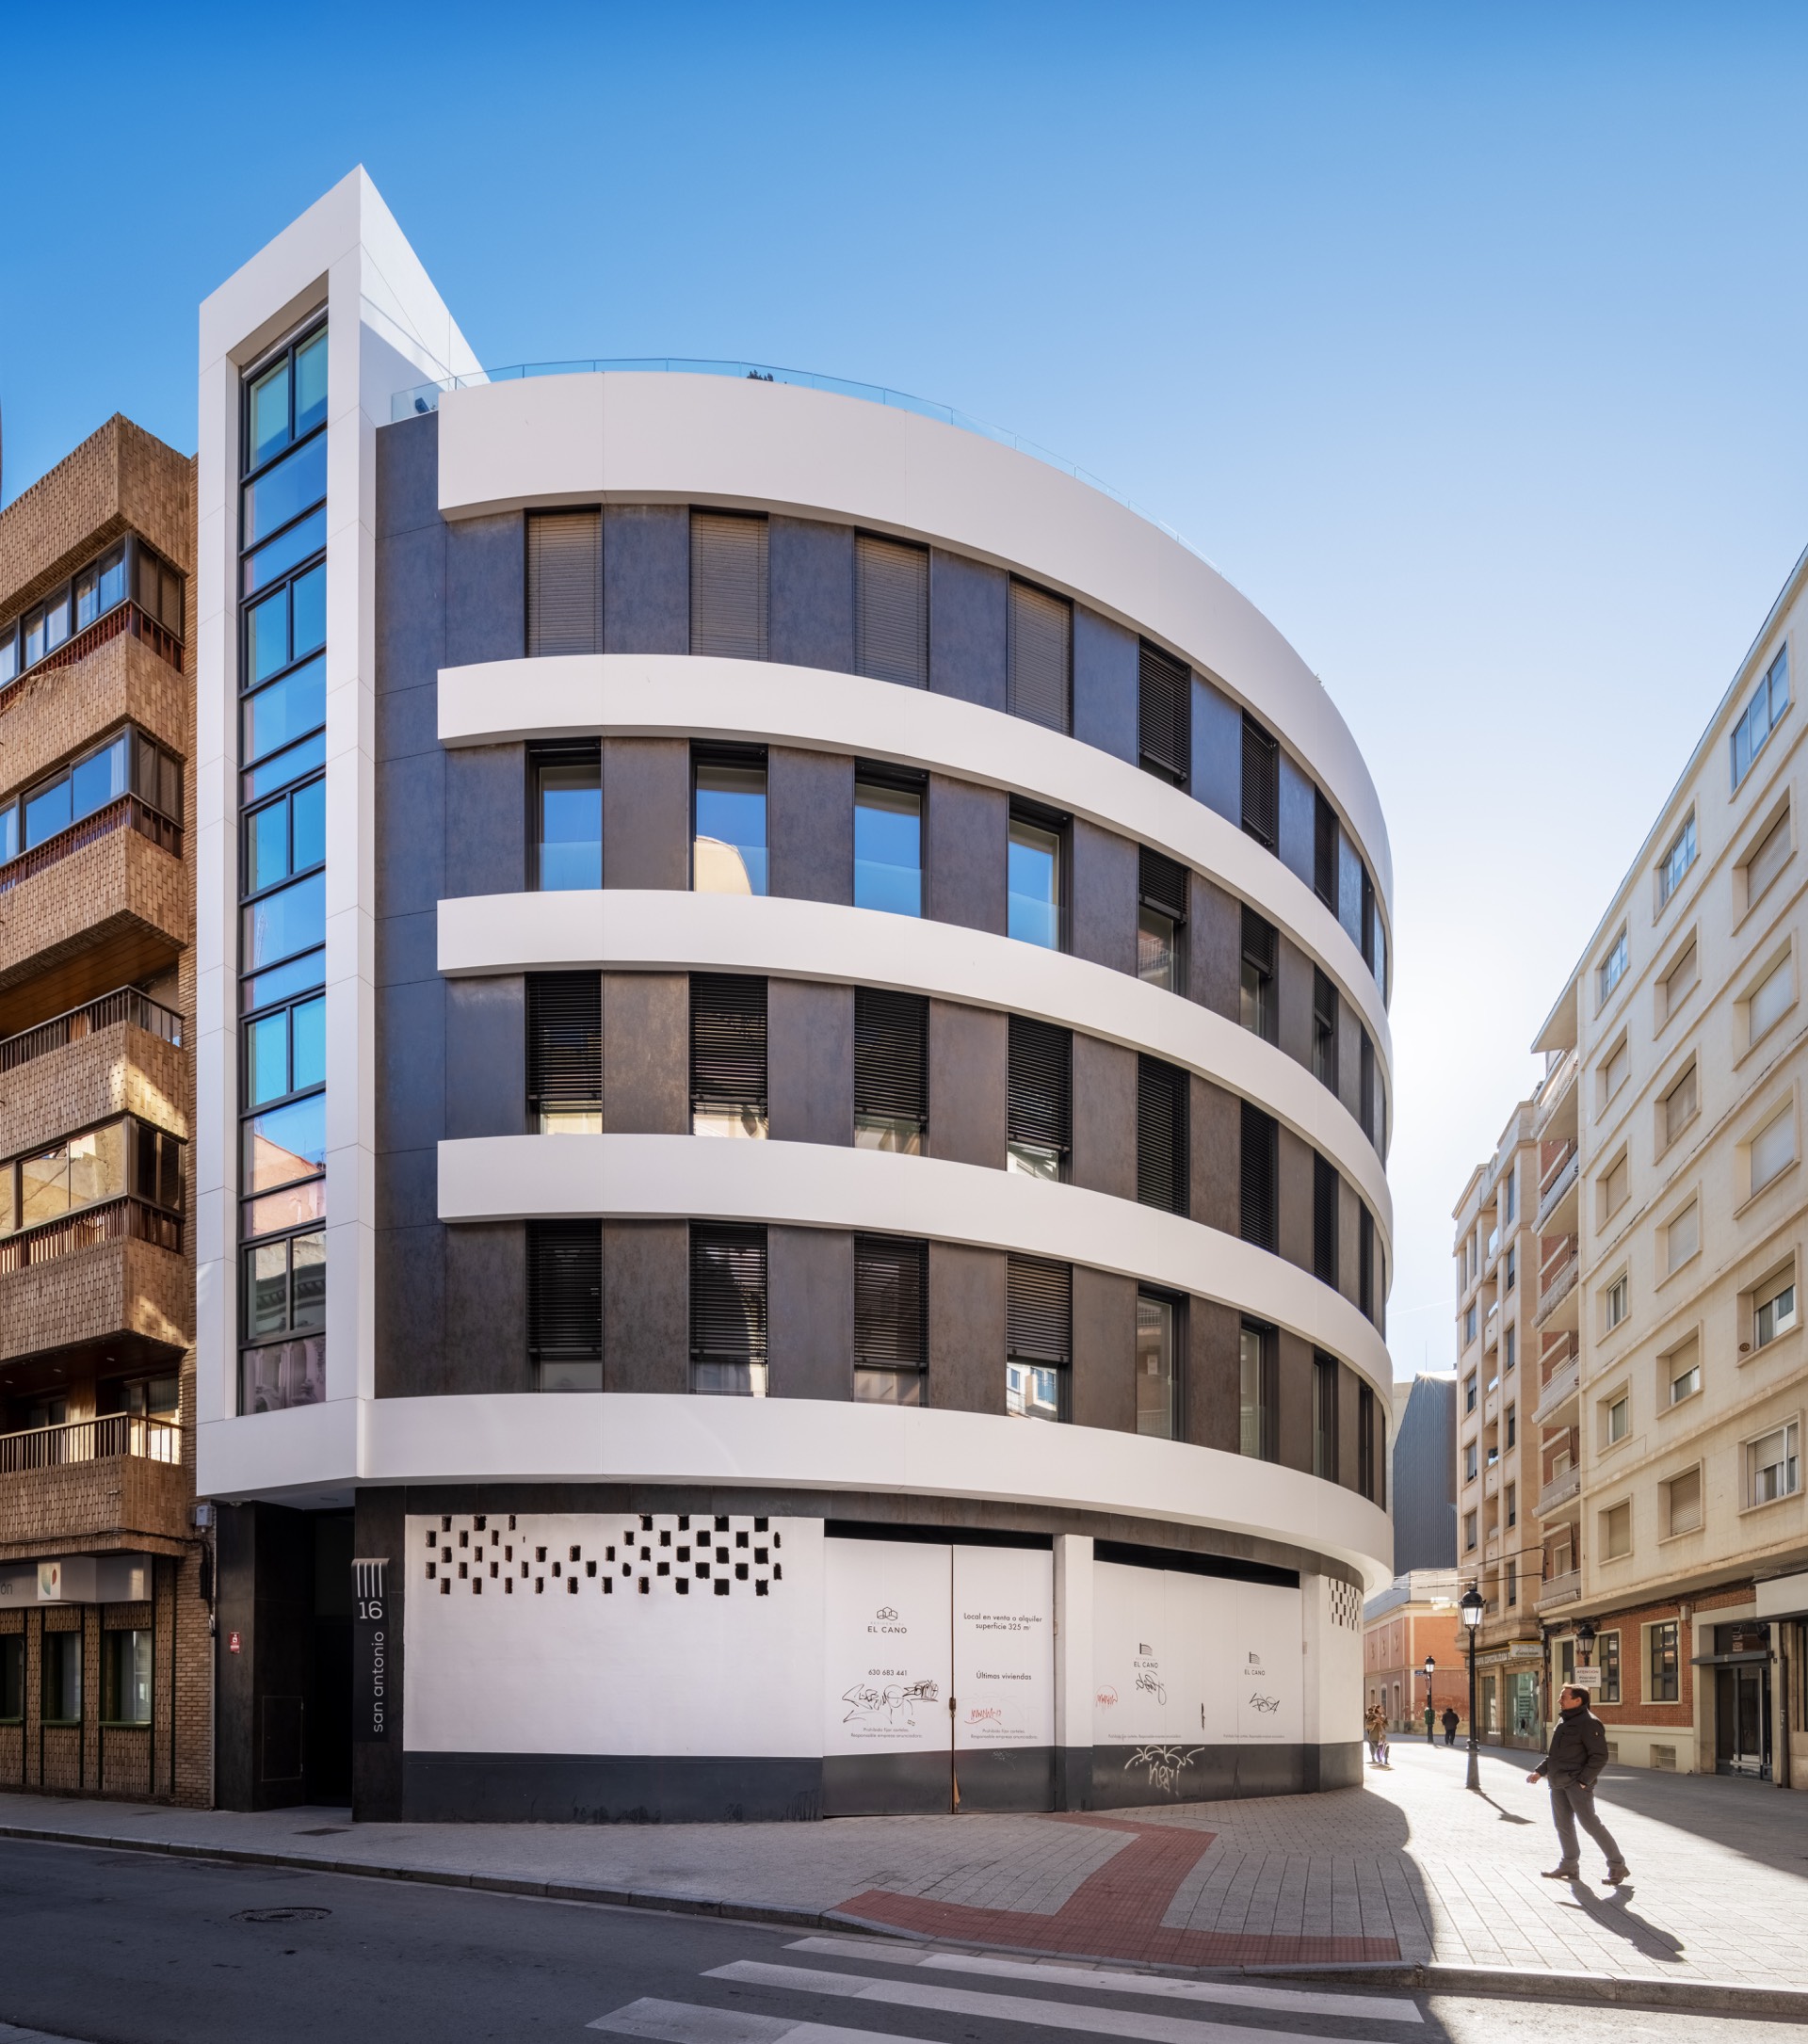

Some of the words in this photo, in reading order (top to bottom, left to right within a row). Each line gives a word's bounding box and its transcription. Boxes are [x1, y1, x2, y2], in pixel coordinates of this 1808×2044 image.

[359, 1601, 383, 1619] 16
[1018, 1615, 1042, 1623] alquiler
[881, 1626, 908, 1634] CANO
[976, 1622, 1007, 1631] superficie
[371, 1632, 384, 1697] antonio
[1142, 1661, 1159, 1669] CANO
[976, 1669, 1000, 1680] Últimas
[1001, 1672, 1032, 1681] viviendas
[373, 1702, 384, 1732] san
